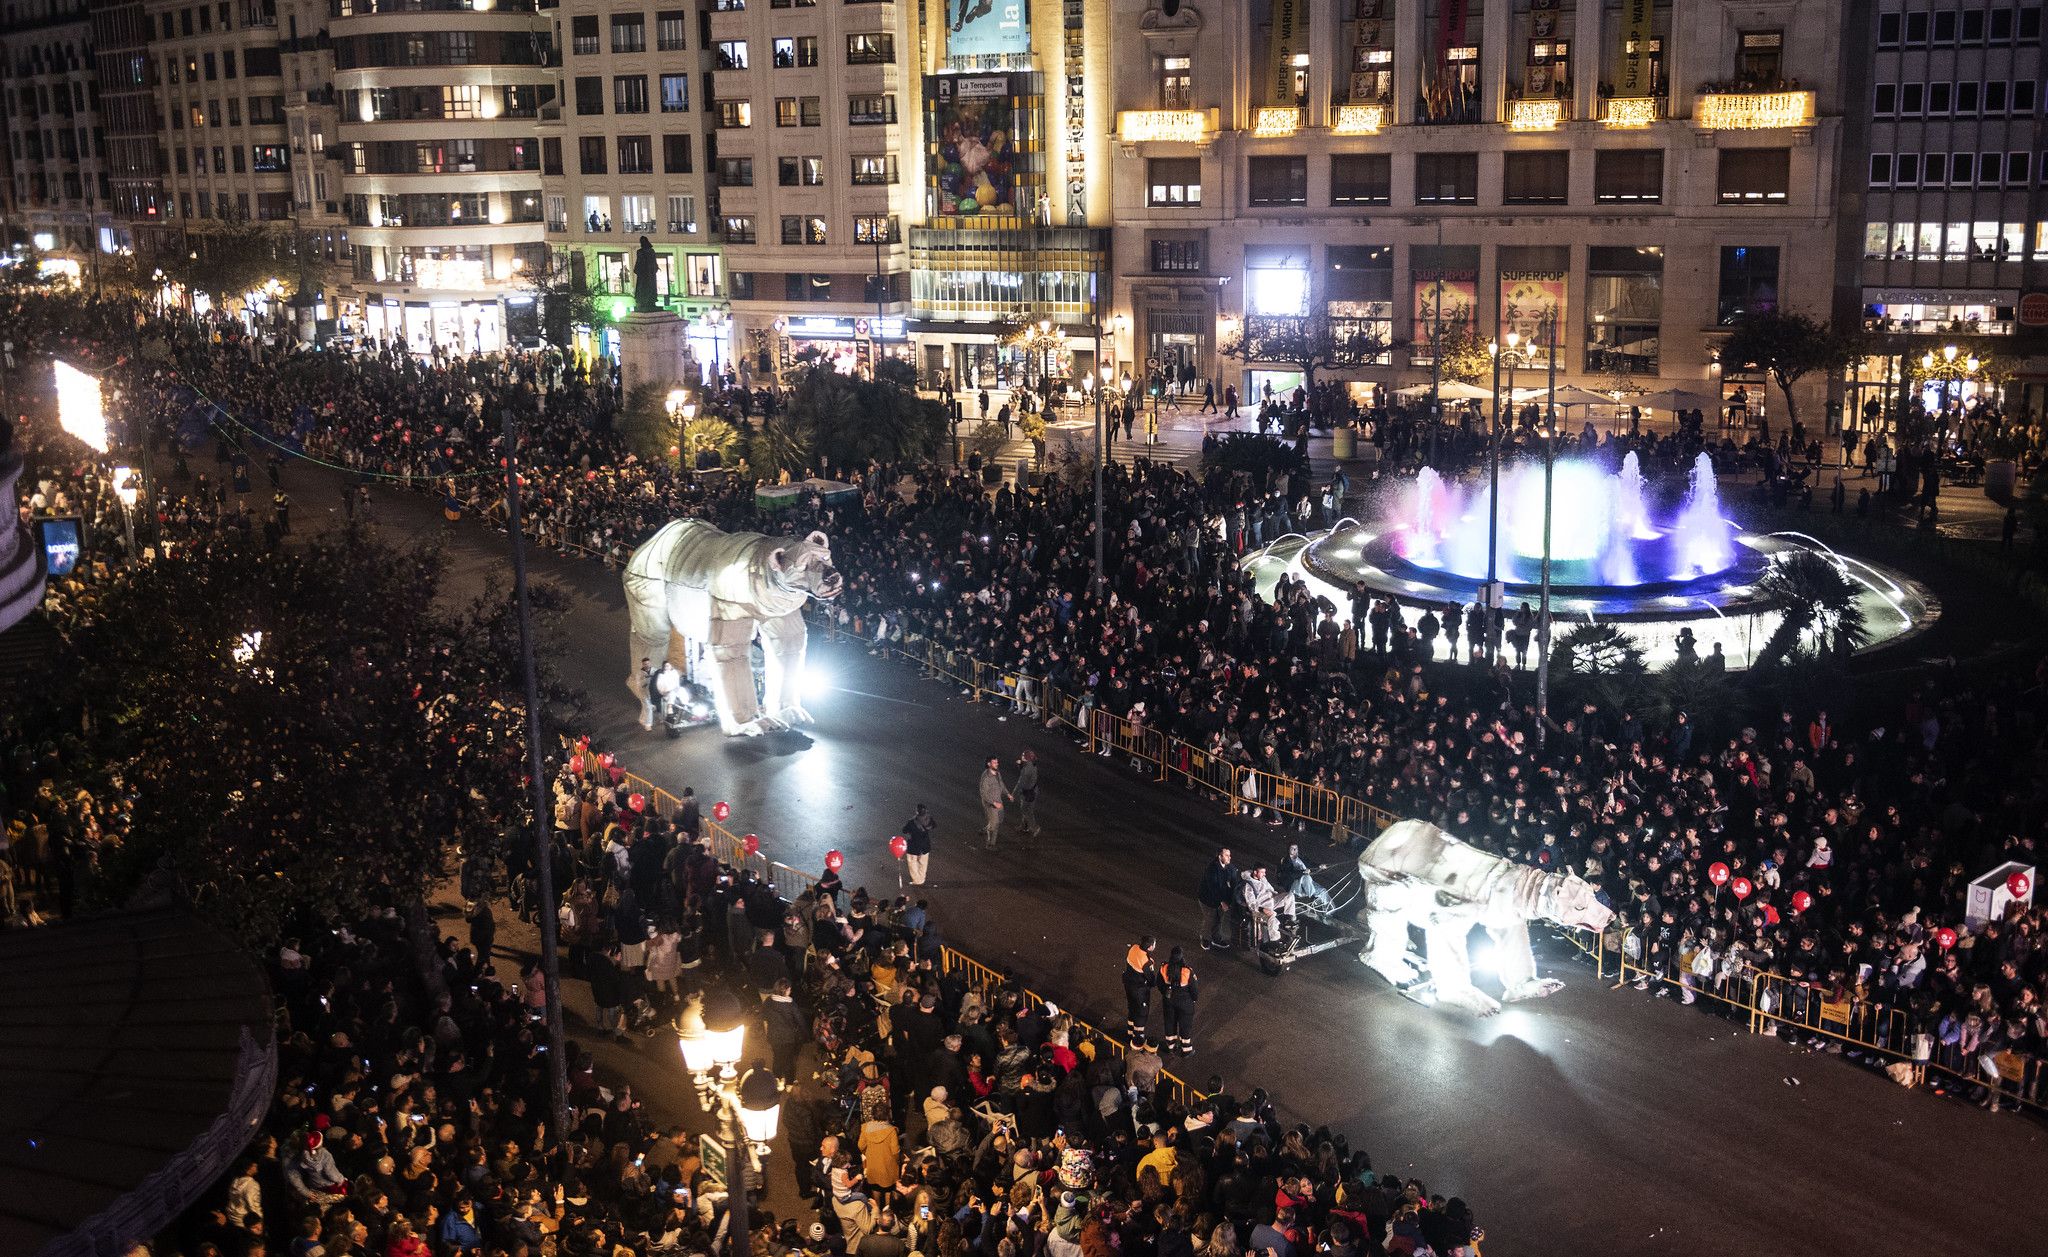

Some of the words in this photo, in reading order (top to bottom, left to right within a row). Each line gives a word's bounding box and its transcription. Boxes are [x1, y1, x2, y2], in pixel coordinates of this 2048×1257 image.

[999, 4, 1020, 29] la
[1282, 0, 1293, 39] WARHO
[1277, 46, 1290, 100] SUPERPOP
[960, 82, 969, 90] La
[1502, 270, 1564, 281] SUPERPOP
